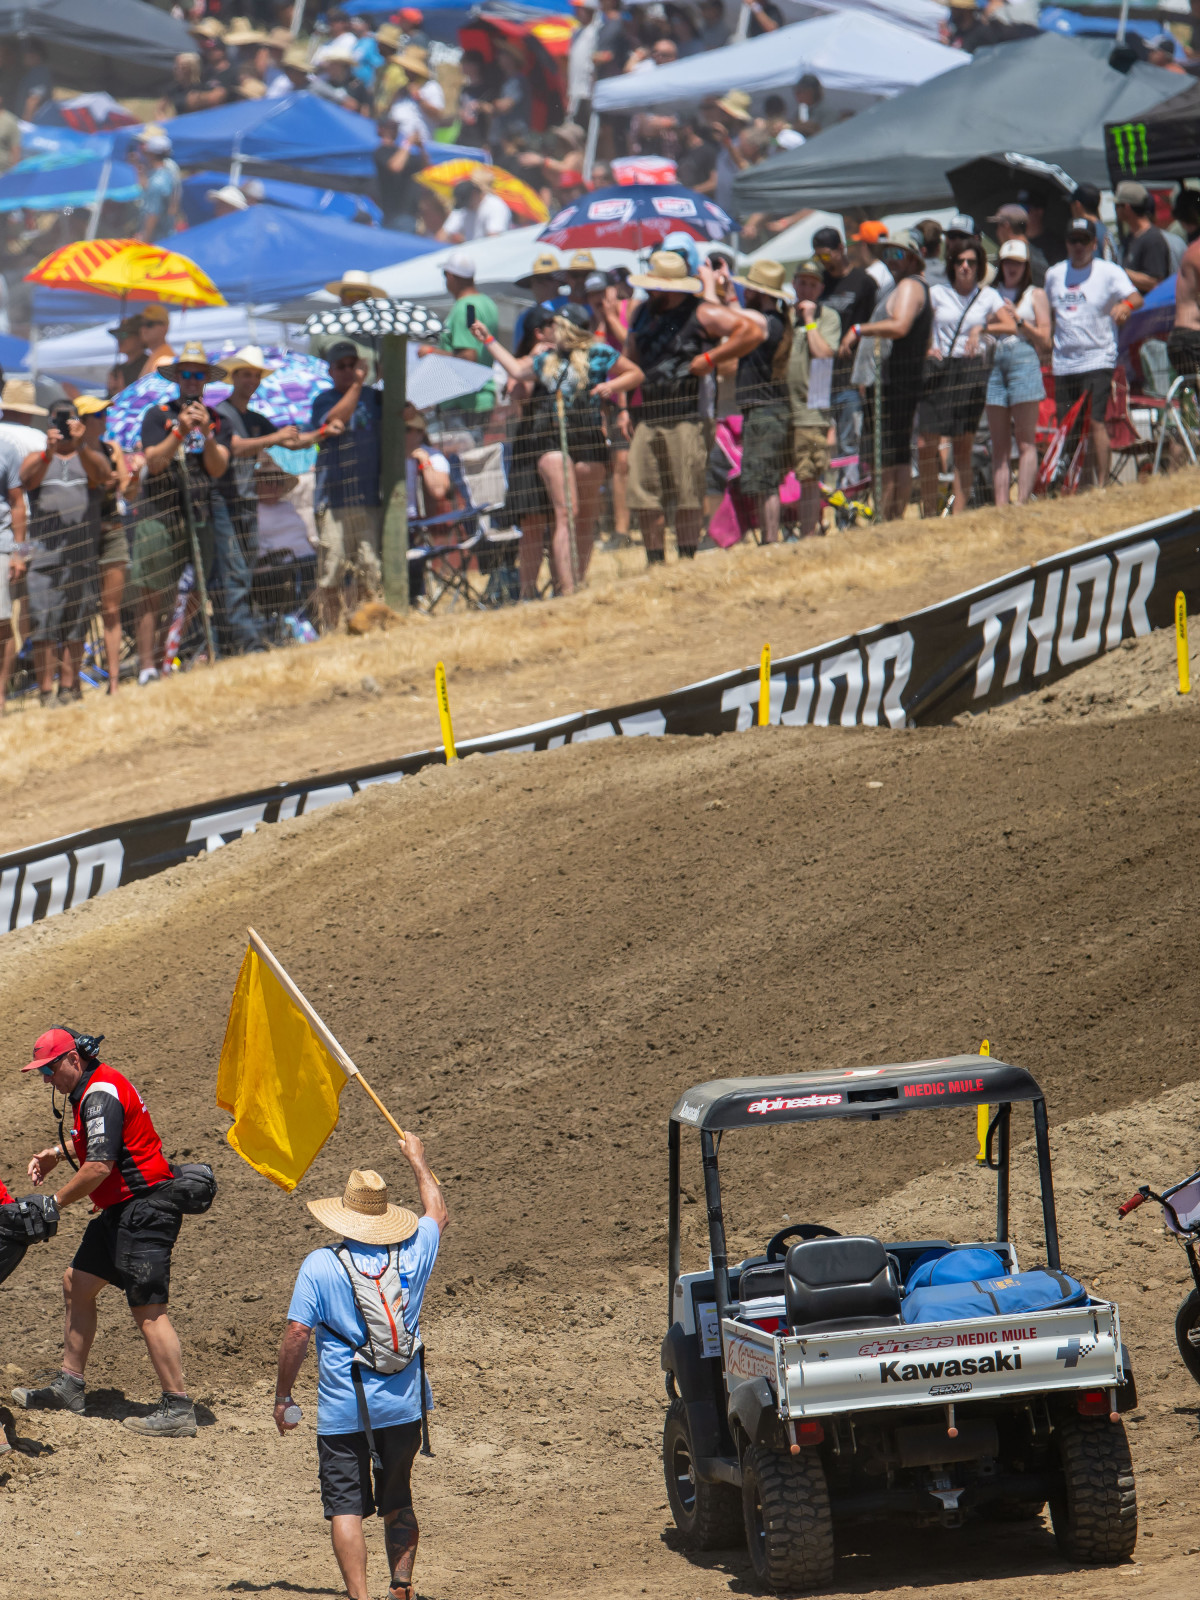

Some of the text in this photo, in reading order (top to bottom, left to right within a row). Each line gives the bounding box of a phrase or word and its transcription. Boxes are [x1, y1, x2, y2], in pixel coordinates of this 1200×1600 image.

[968, 539, 1161, 698] THOR
[748, 1079, 984, 1115] alpinestars MEDIC MULE
[957, 1331, 998, 1347] MEDIC
[1002, 1327, 1037, 1342] MULE
[880, 1346, 1022, 1384] Kawasaki
[929, 1382, 972, 1394] SEDONA
